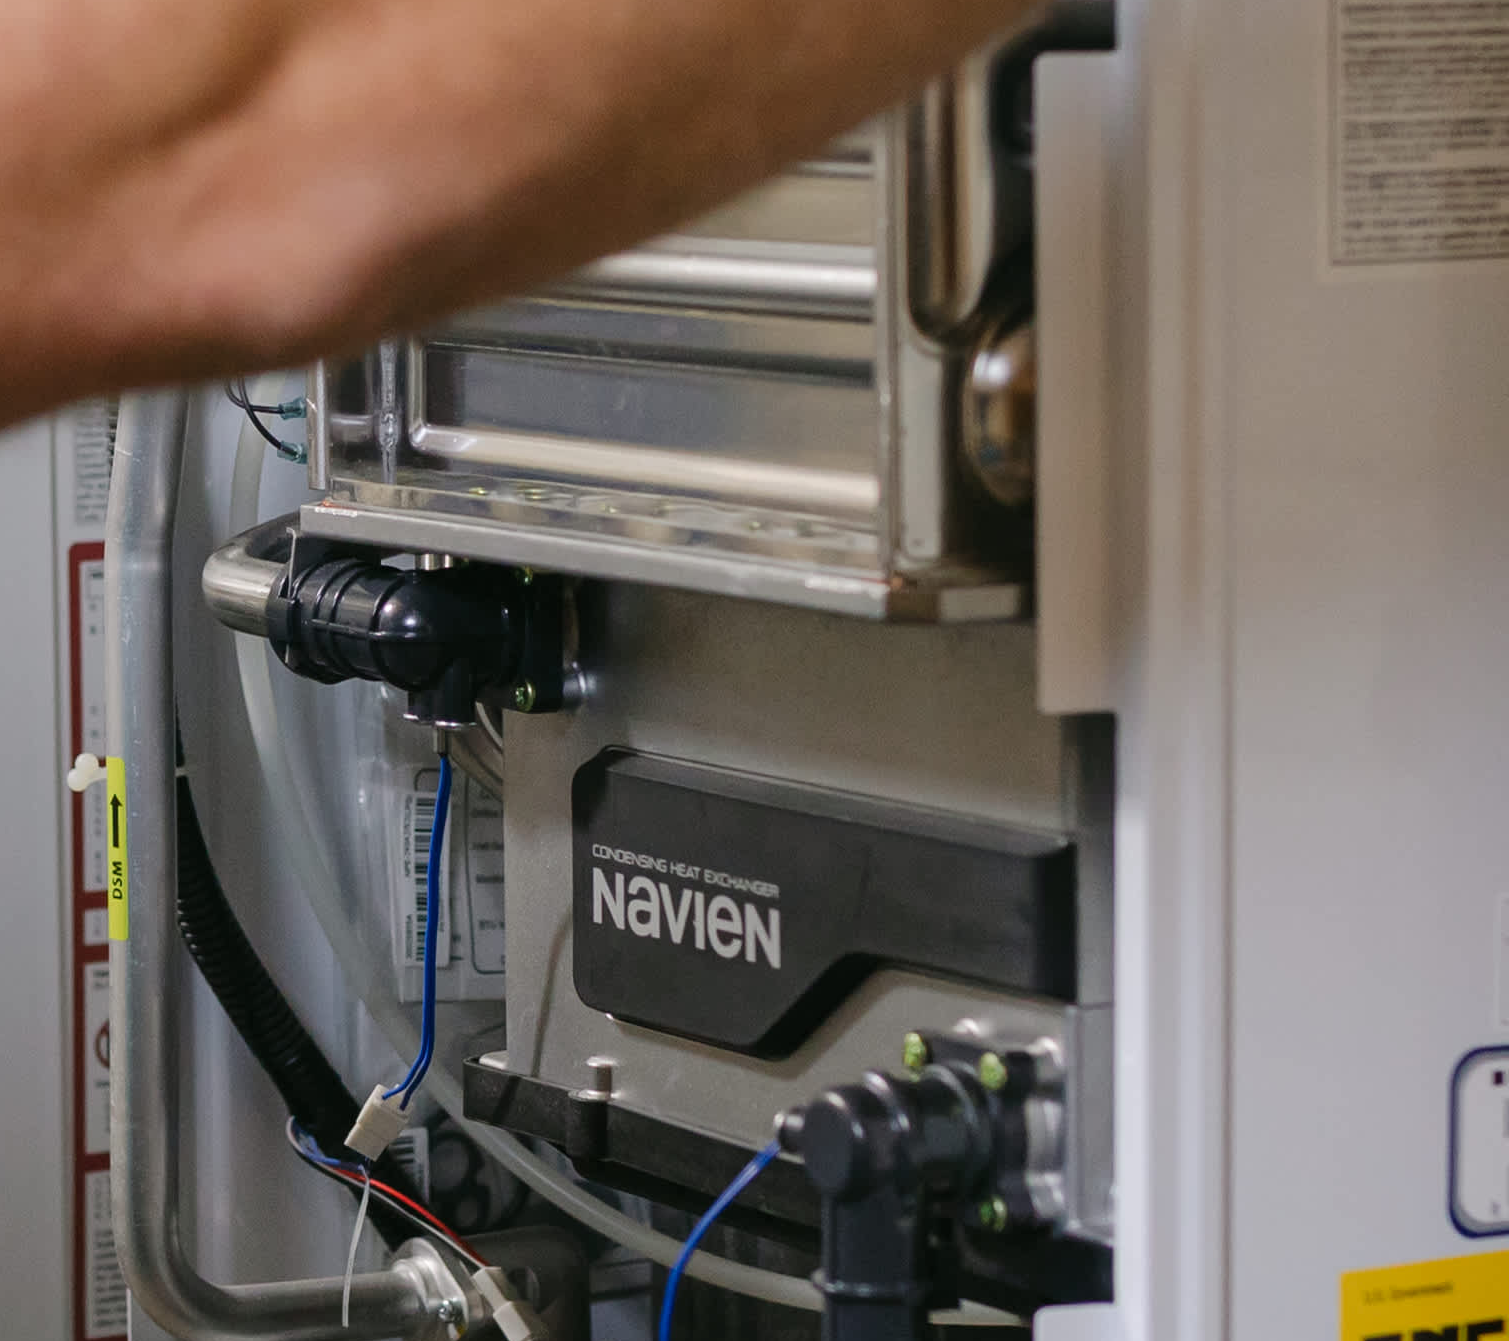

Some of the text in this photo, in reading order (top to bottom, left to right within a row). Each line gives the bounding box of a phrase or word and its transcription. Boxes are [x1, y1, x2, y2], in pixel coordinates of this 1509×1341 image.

[112, 860, 123, 901] DSM
[592, 842, 780, 899] CONDENSING HEAT EXCHANGER
